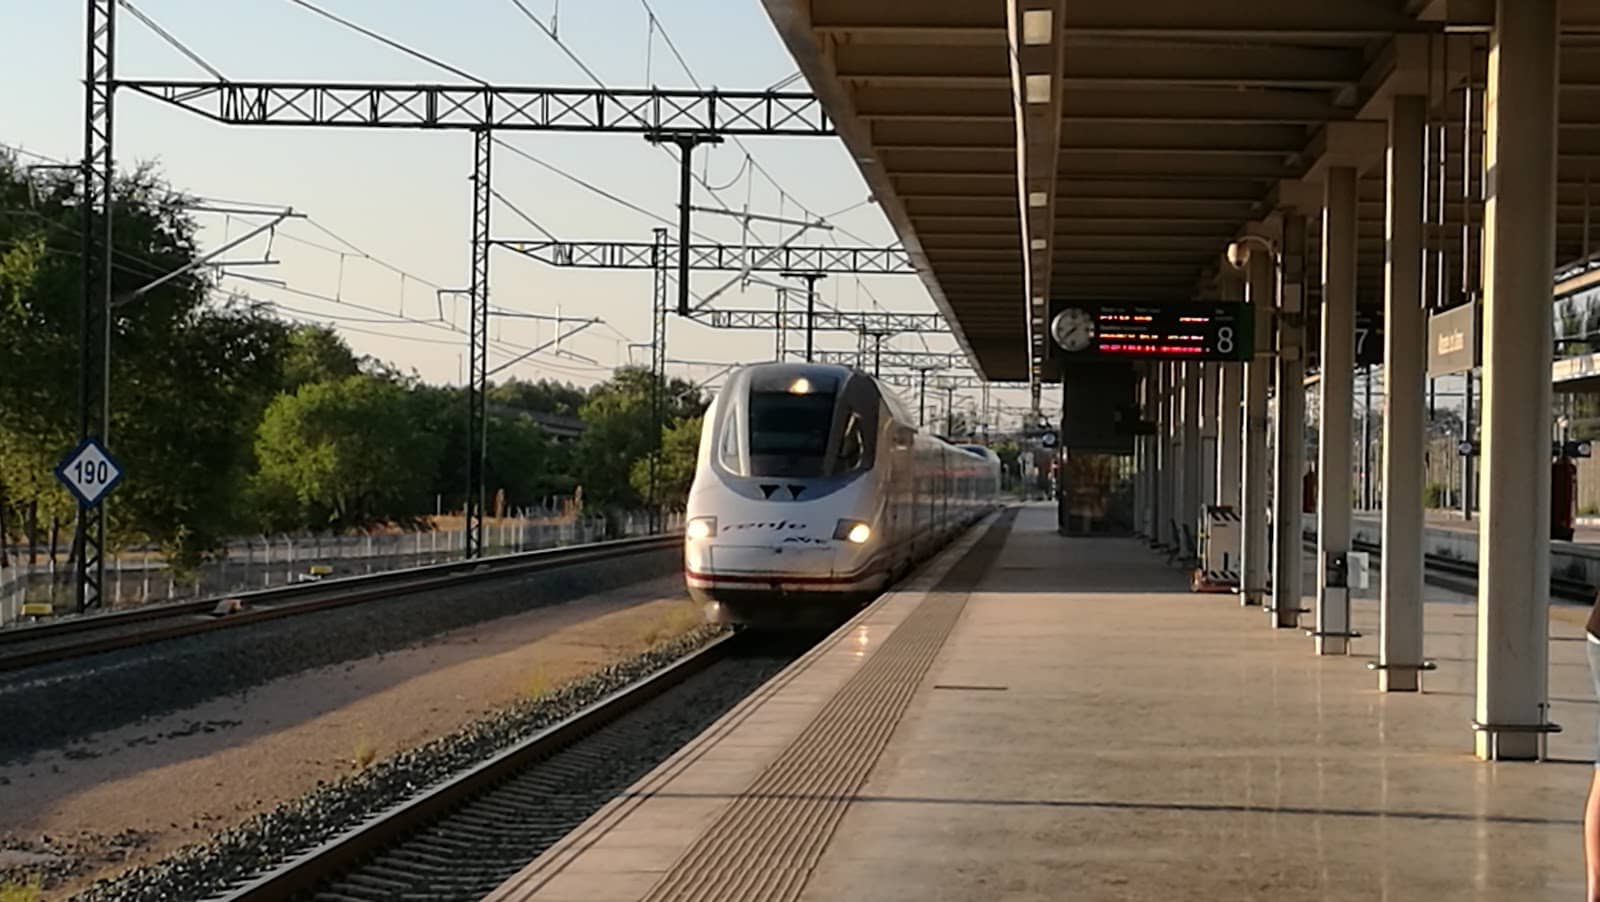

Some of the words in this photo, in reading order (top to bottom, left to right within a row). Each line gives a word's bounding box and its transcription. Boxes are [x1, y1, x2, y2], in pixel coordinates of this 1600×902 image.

[1217, 327, 1233, 353] 8
[1354, 328, 1369, 354] 7
[74, 460, 108, 484] 190
[722, 519, 808, 532] renfe
